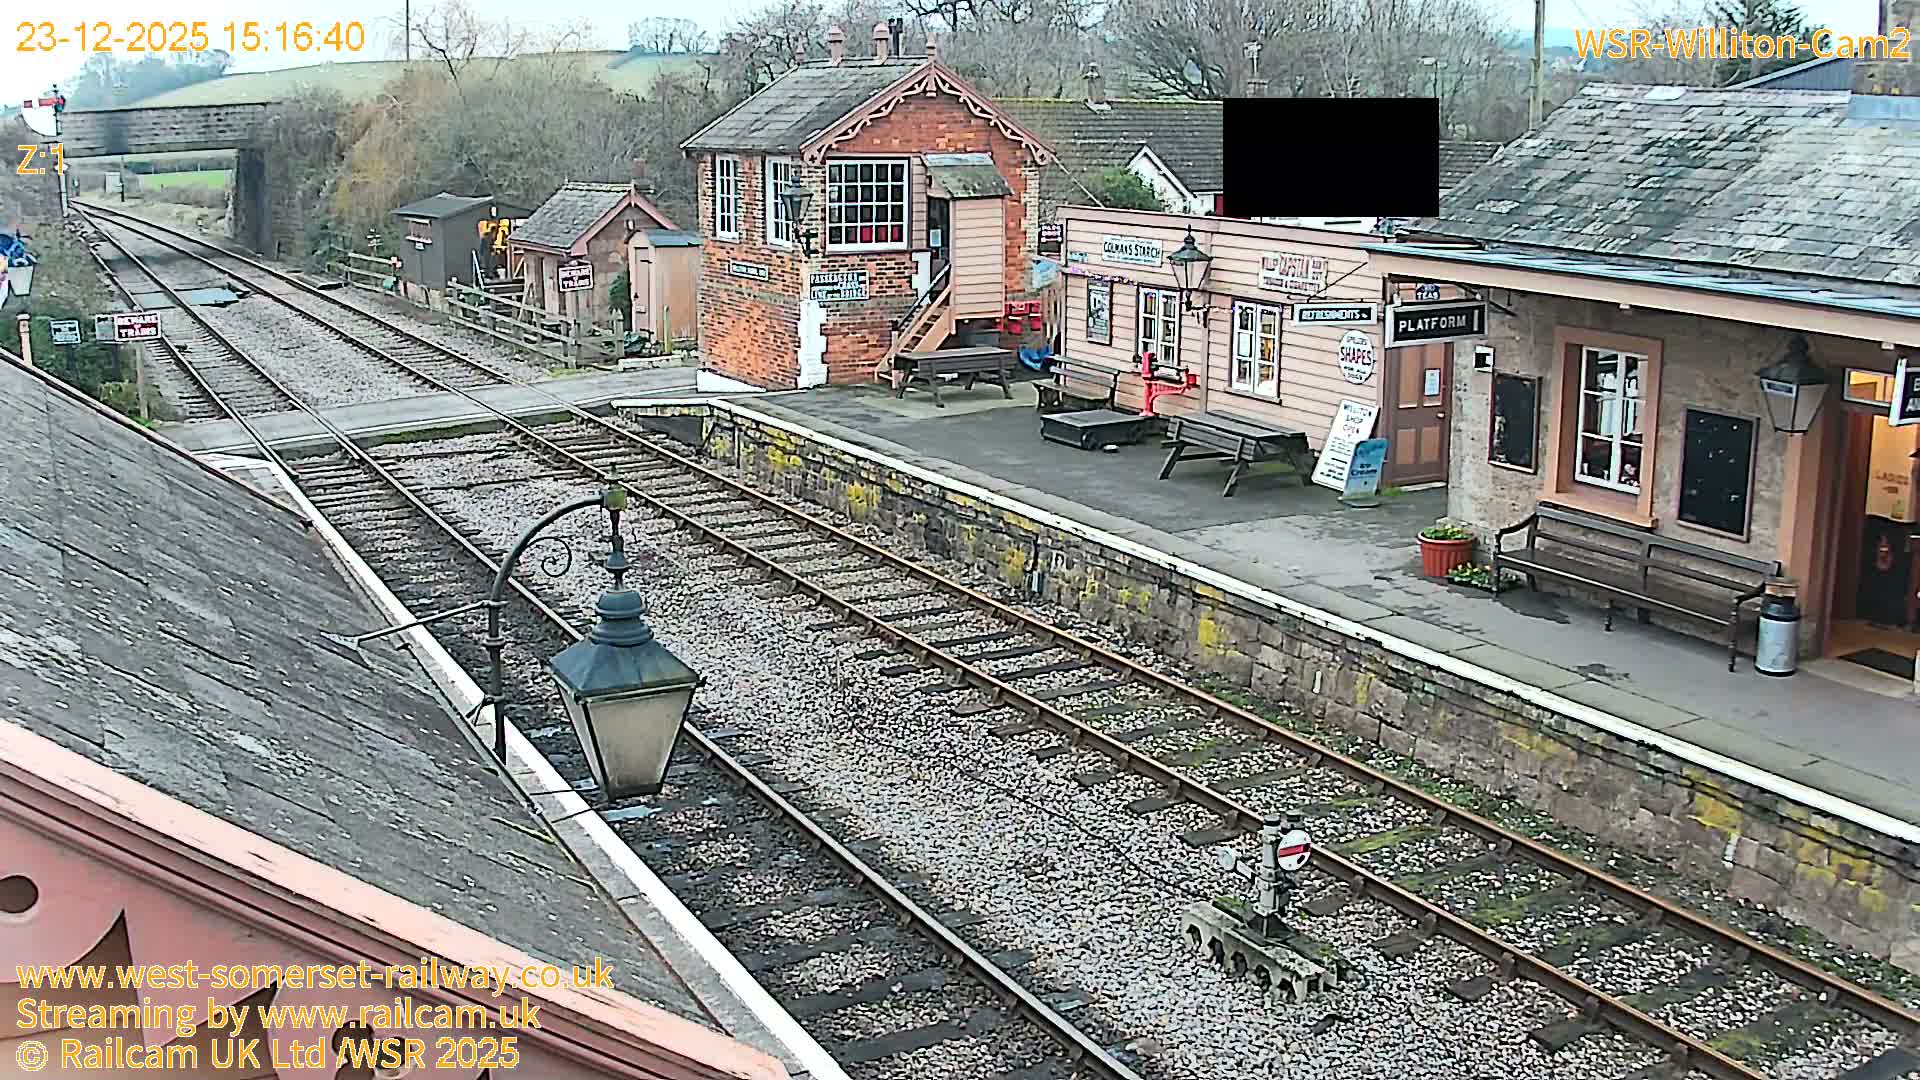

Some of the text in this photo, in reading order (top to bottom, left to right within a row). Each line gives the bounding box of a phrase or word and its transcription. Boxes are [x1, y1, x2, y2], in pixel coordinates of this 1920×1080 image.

[1134, 244, 1161, 259] STARCH
[1399, 314, 1467, 332] PLATFORM
[1340, 346, 1372, 366] SHAPES
